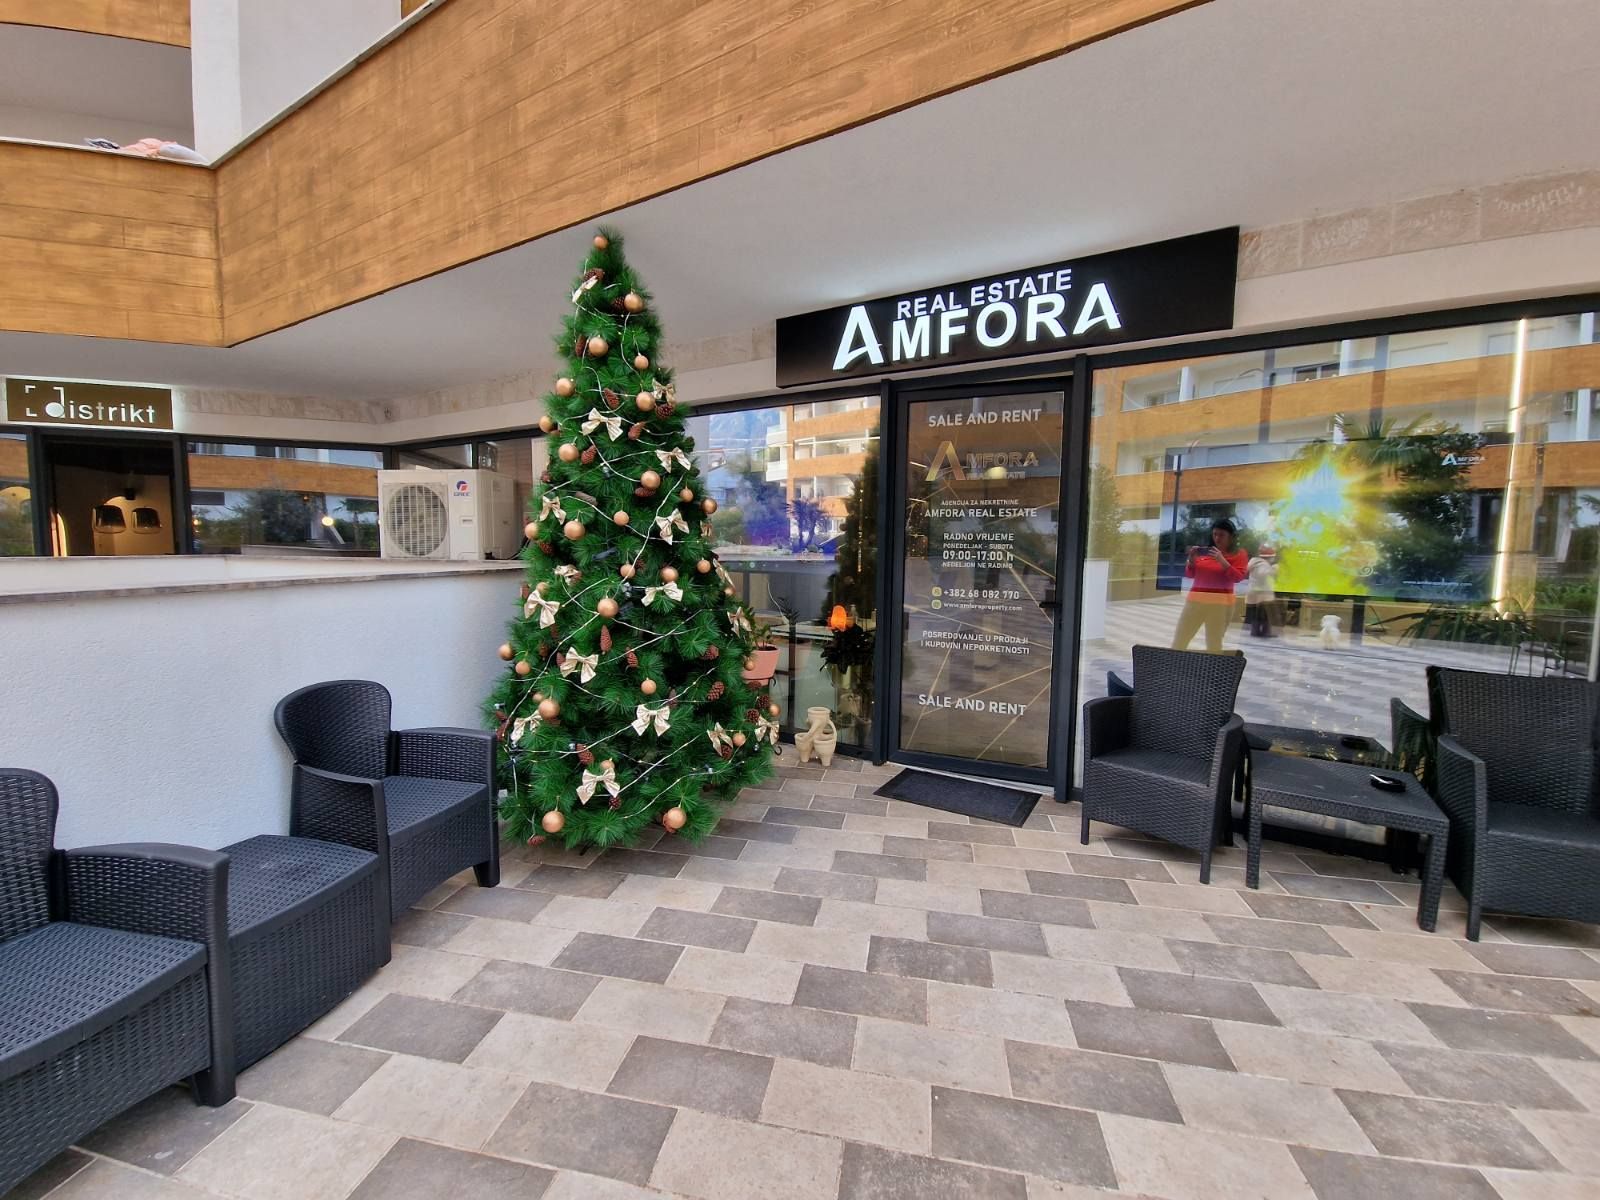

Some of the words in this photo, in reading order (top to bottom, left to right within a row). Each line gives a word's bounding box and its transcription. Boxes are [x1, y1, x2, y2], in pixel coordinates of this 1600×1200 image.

[897, 292, 963, 319] REAL
[970, 268, 1073, 308] ESTATE
[832, 282, 1124, 371] AMFORA
[45, 386, 156, 424] distrikt
[928, 413, 963, 428] SALE
[966, 411, 998, 425] AND
[1001, 408, 1042, 423] RENT
[924, 440, 1040, 481] AMFORA
[924, 508, 966, 518] AMFORA
[968, 508, 996, 518] REAL
[998, 507, 1038, 518] ESTATE
[943, 532, 974, 541] RADNO
[976, 532, 1014, 541] VRIJEME
[1006, 551, 1014, 561] h
[943, 588, 966, 598] +382
[967, 589, 979, 598] 68
[982, 589, 1000, 600] 082
[1002, 590, 1020, 600] 770
[922, 630, 984, 642] POSREDOVANJE
[993, 635, 1029, 645] PRODAJI
[925, 641, 961, 650] KUPOVINI
[962, 643, 1030, 655] NEPOKRETNOSTI
[918, 693, 952, 708] SALE
[954, 697, 985, 711] AND
[988, 701, 1027, 716] RENT
